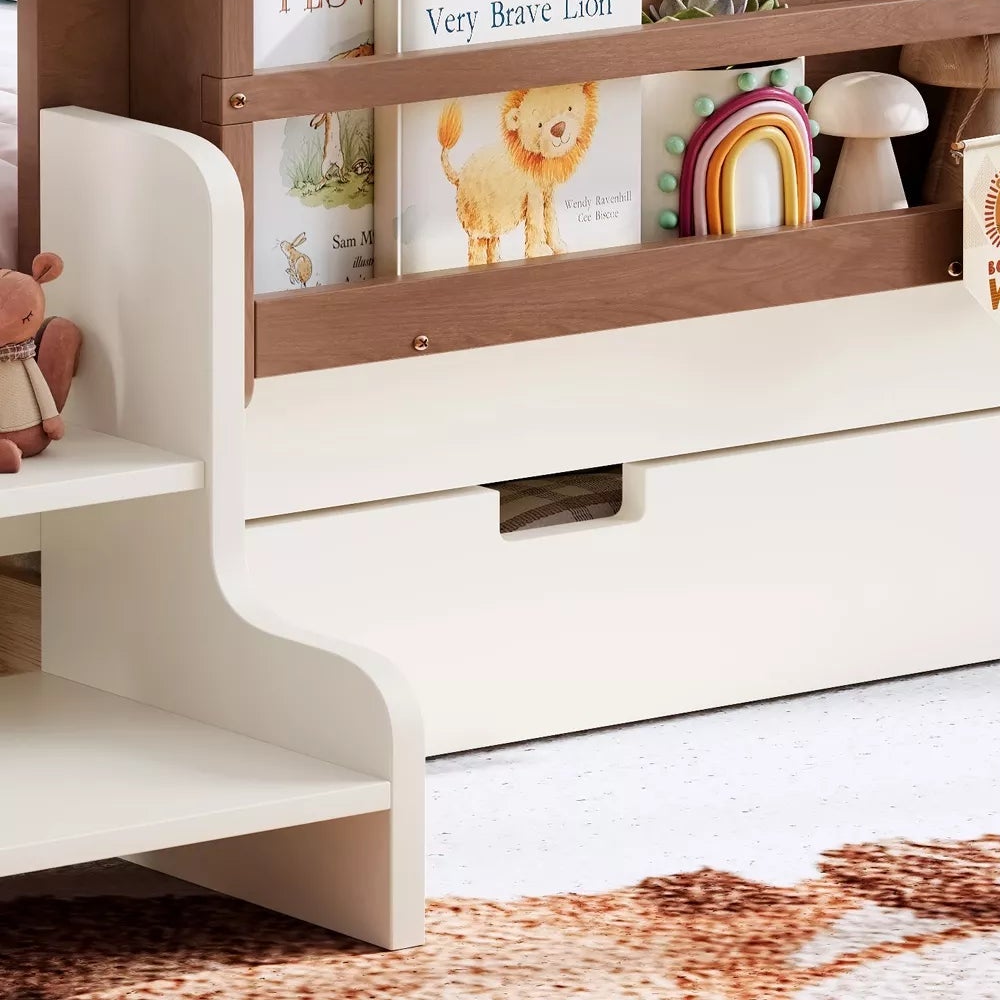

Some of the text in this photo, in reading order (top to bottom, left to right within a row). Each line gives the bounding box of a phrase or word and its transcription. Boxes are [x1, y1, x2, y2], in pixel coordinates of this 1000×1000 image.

[426, 7, 479, 43] Very
[490, 1, 552, 29] Brave
[564, 190, 632, 212] Wendy Ravenhill
[332, 234, 357, 250] Sam
